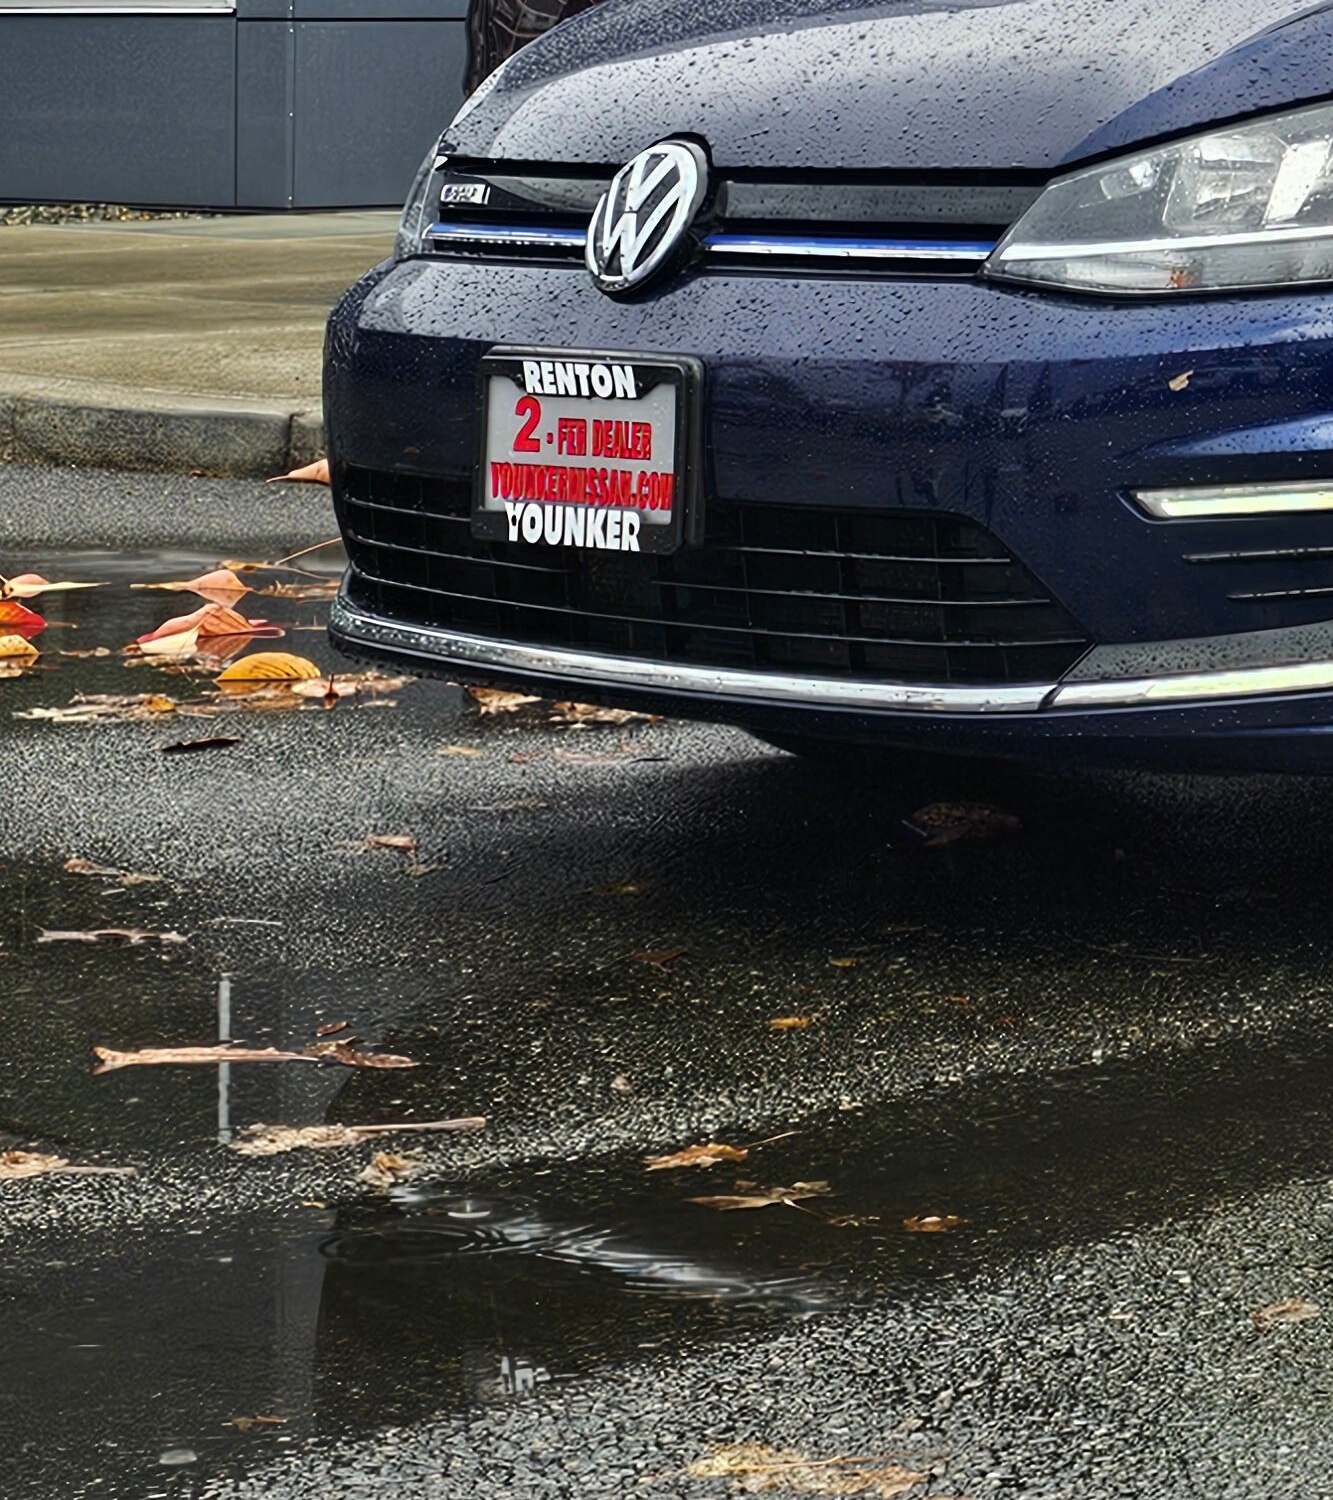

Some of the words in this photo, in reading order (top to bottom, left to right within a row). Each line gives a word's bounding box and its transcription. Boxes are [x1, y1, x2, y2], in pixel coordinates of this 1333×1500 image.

[522, 361, 637, 399] RENTON
[592, 418, 652, 460] DEALER
[504, 501, 641, 552] YOUNKER
